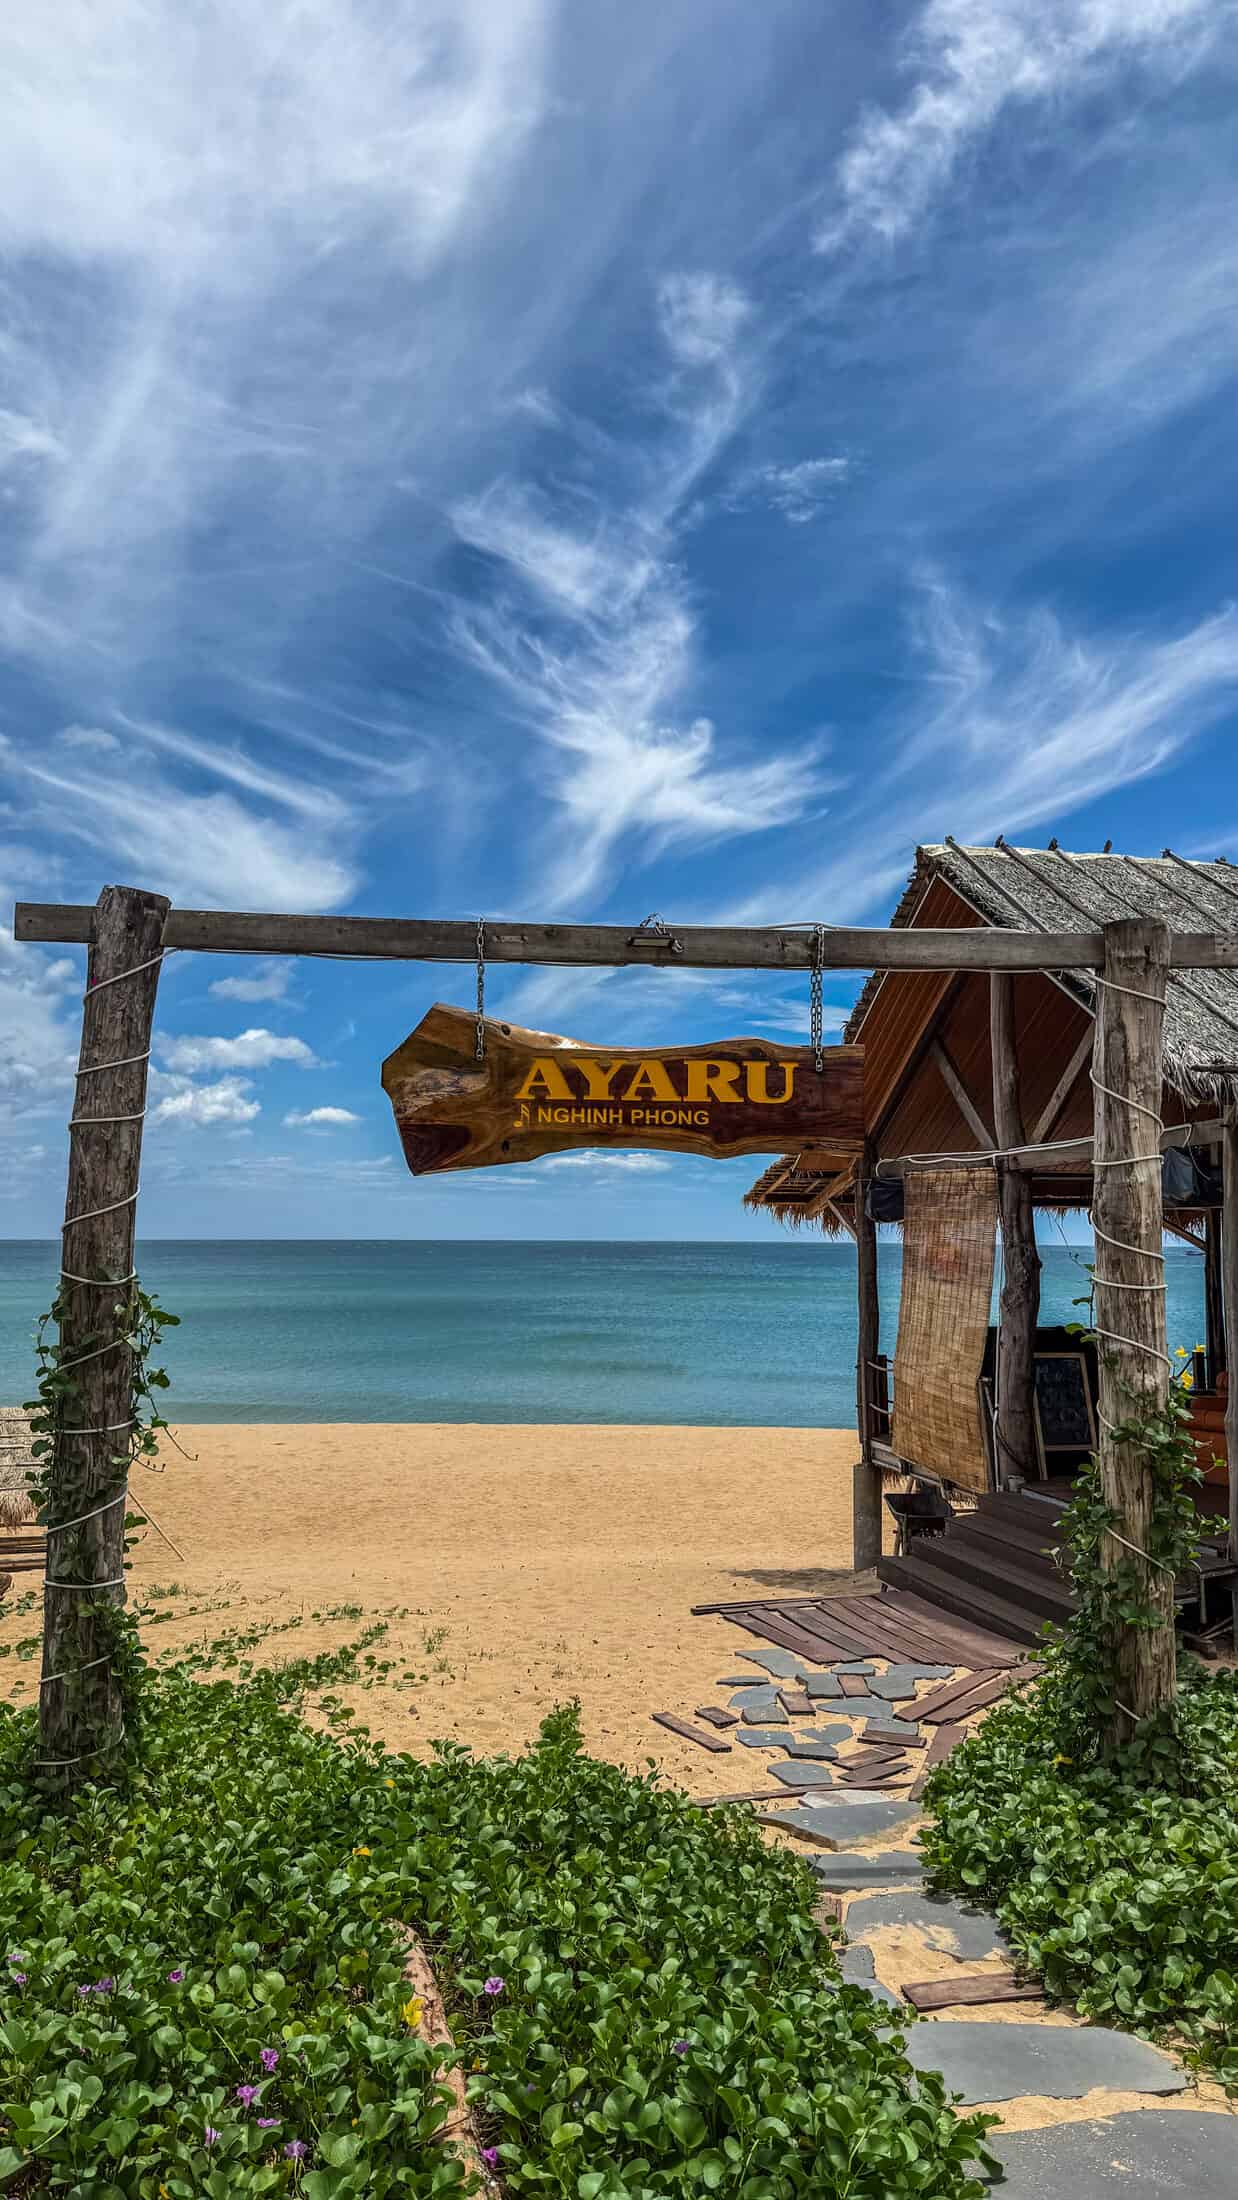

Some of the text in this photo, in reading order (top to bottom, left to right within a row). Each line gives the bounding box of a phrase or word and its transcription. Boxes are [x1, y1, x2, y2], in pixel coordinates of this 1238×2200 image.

[514, 1056, 799, 1104] AYARU
[537, 1107, 710, 1126] NGHINH PHONG
